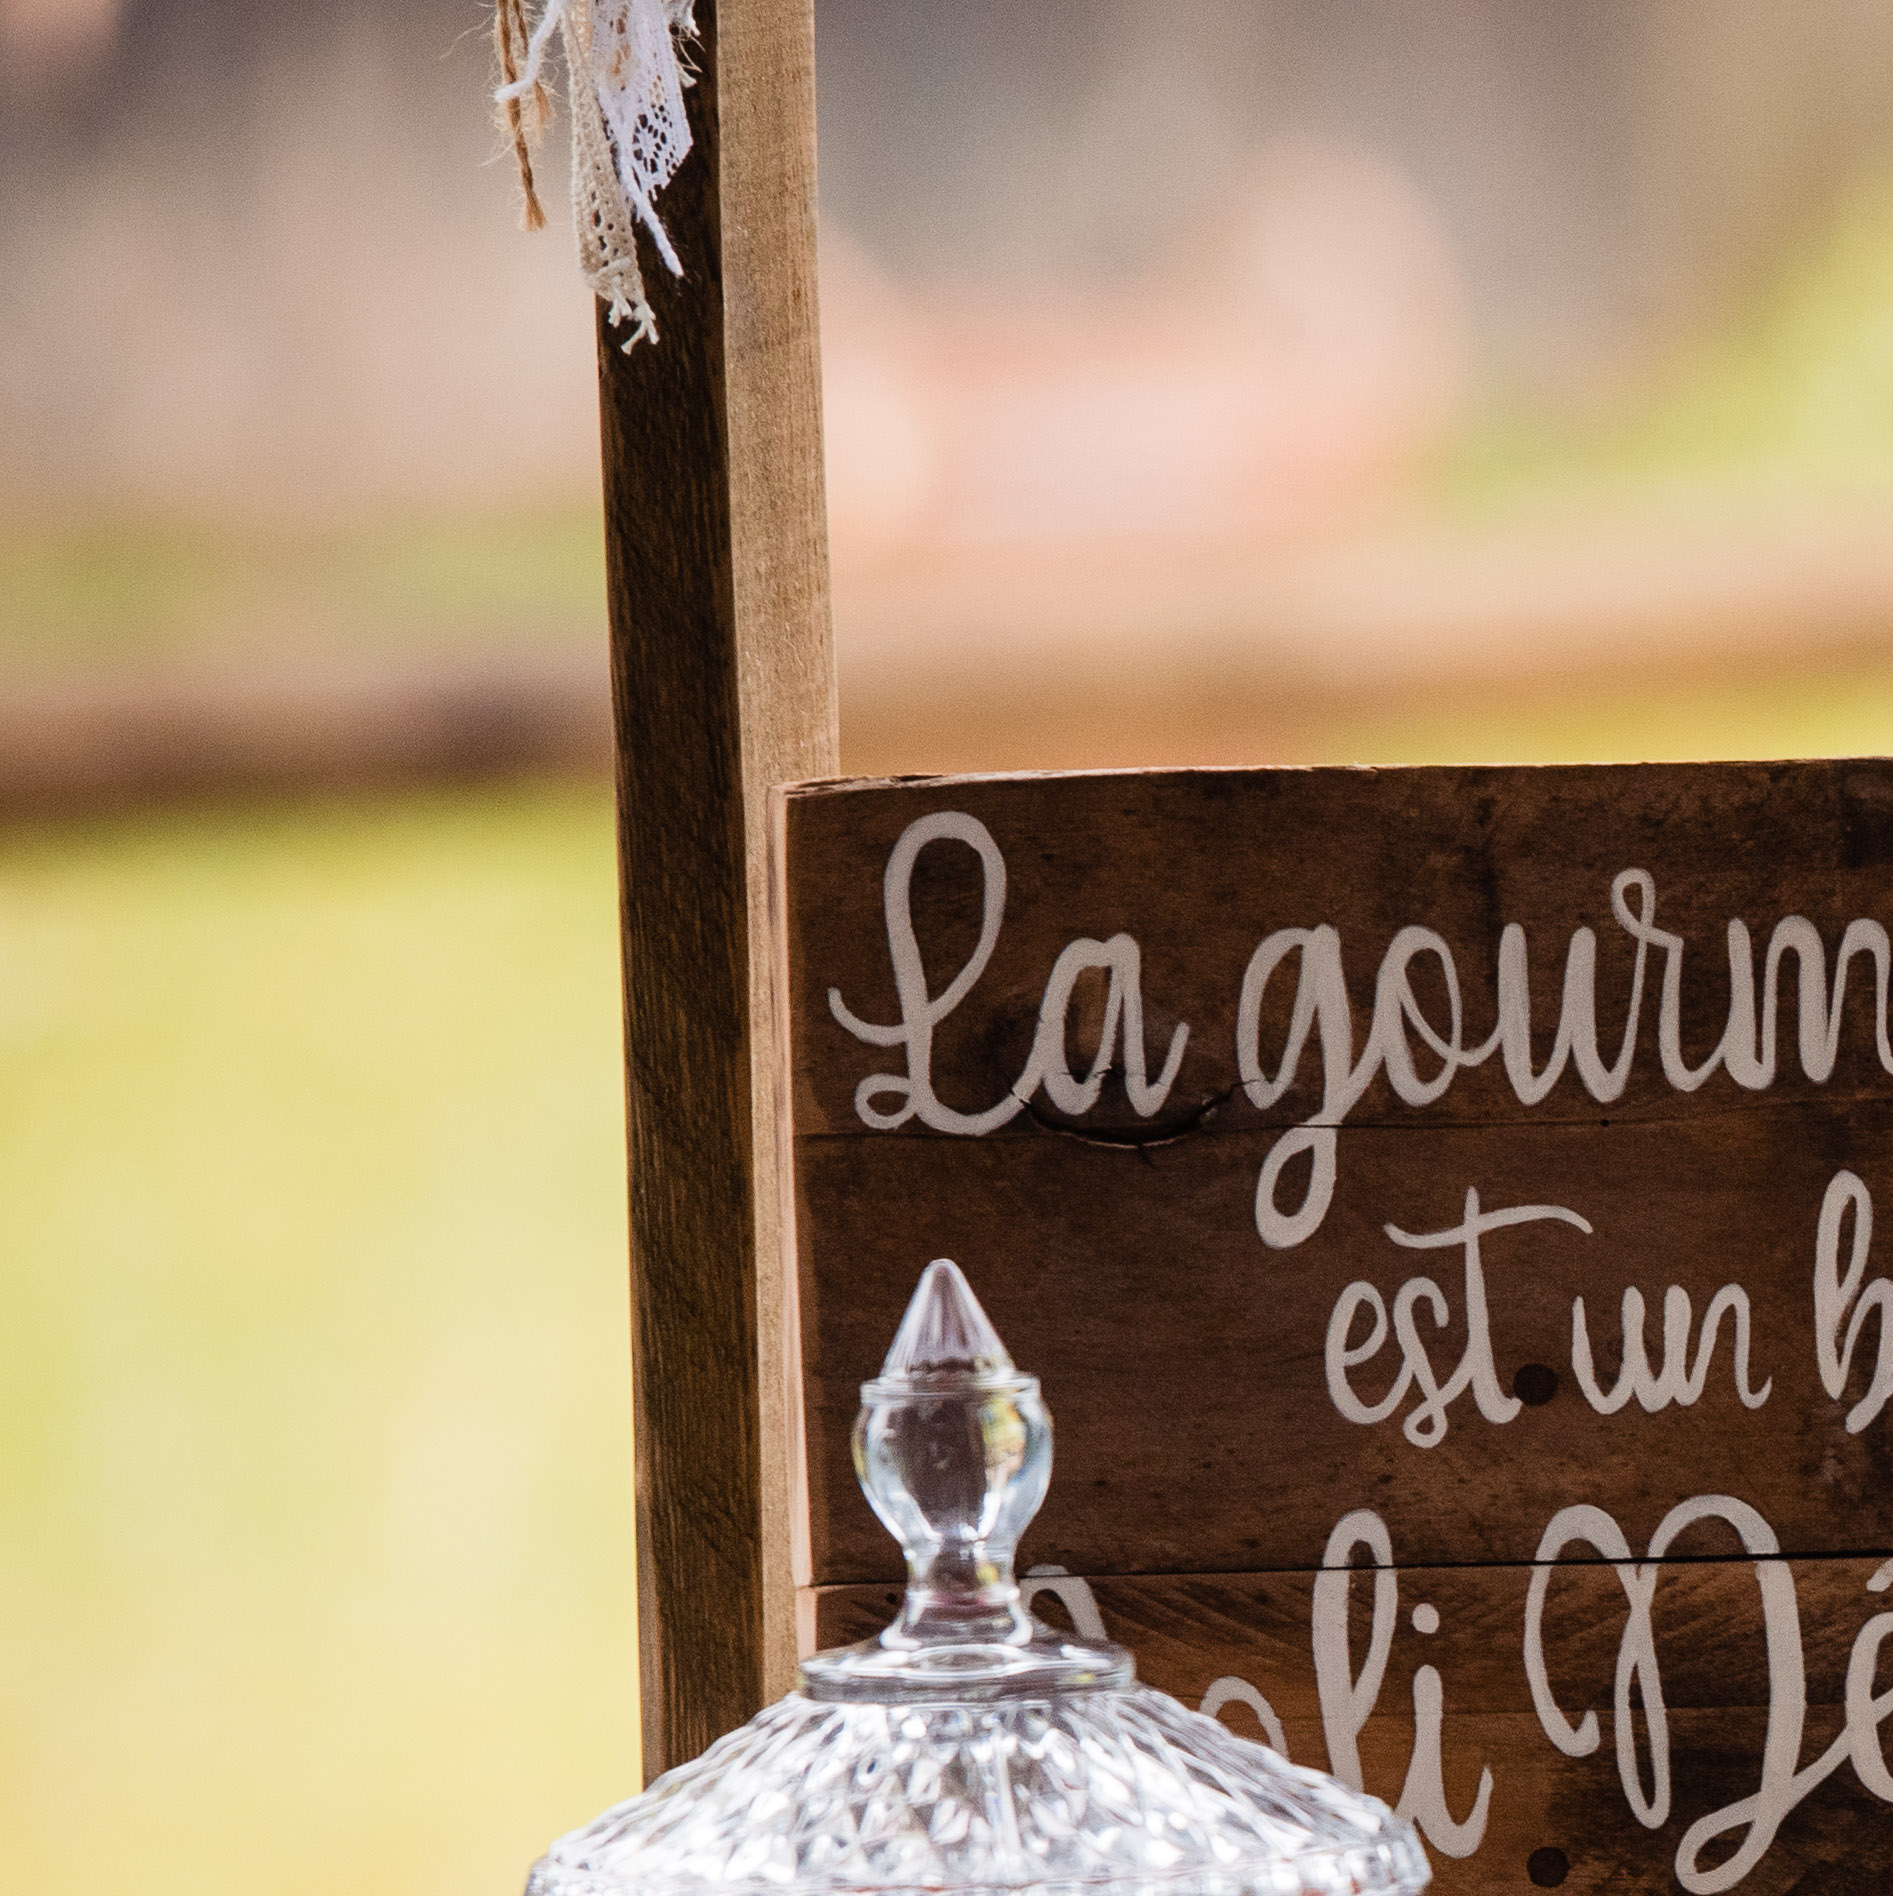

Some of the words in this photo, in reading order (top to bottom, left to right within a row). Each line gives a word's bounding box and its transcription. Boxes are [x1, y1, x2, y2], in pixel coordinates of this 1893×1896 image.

[828, 808, 1190, 1136] La
[1322, 1184, 1594, 1450] est
[1568, 1280, 1774, 1418] un
